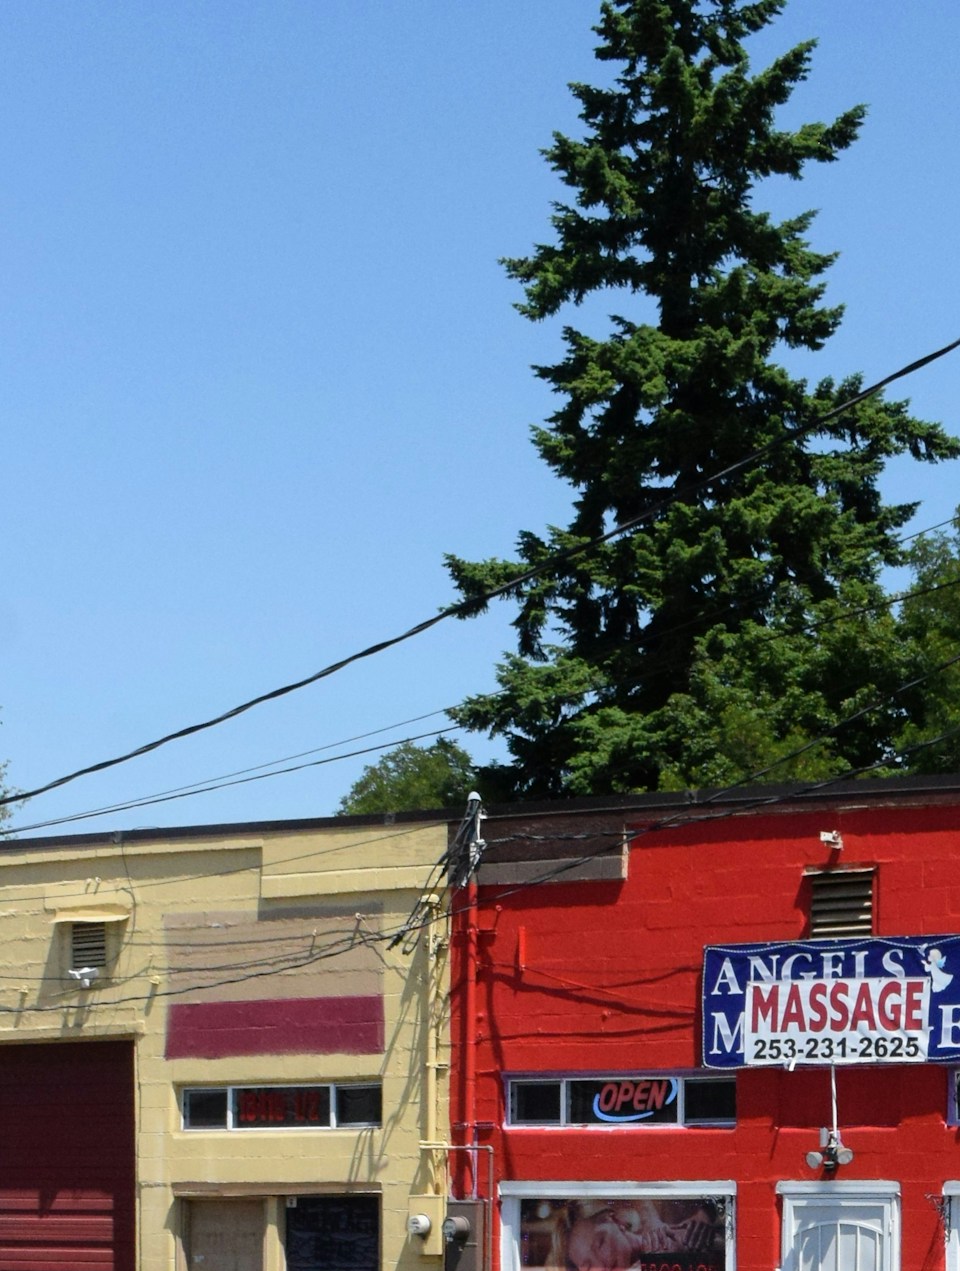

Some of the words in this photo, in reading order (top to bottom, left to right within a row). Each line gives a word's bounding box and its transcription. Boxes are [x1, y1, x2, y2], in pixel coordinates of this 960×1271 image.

[751, 980, 924, 1034] MASSAGE
[753, 1036, 919, 1060] 253-231-2625
[600, 1080, 668, 1112] OPEN
